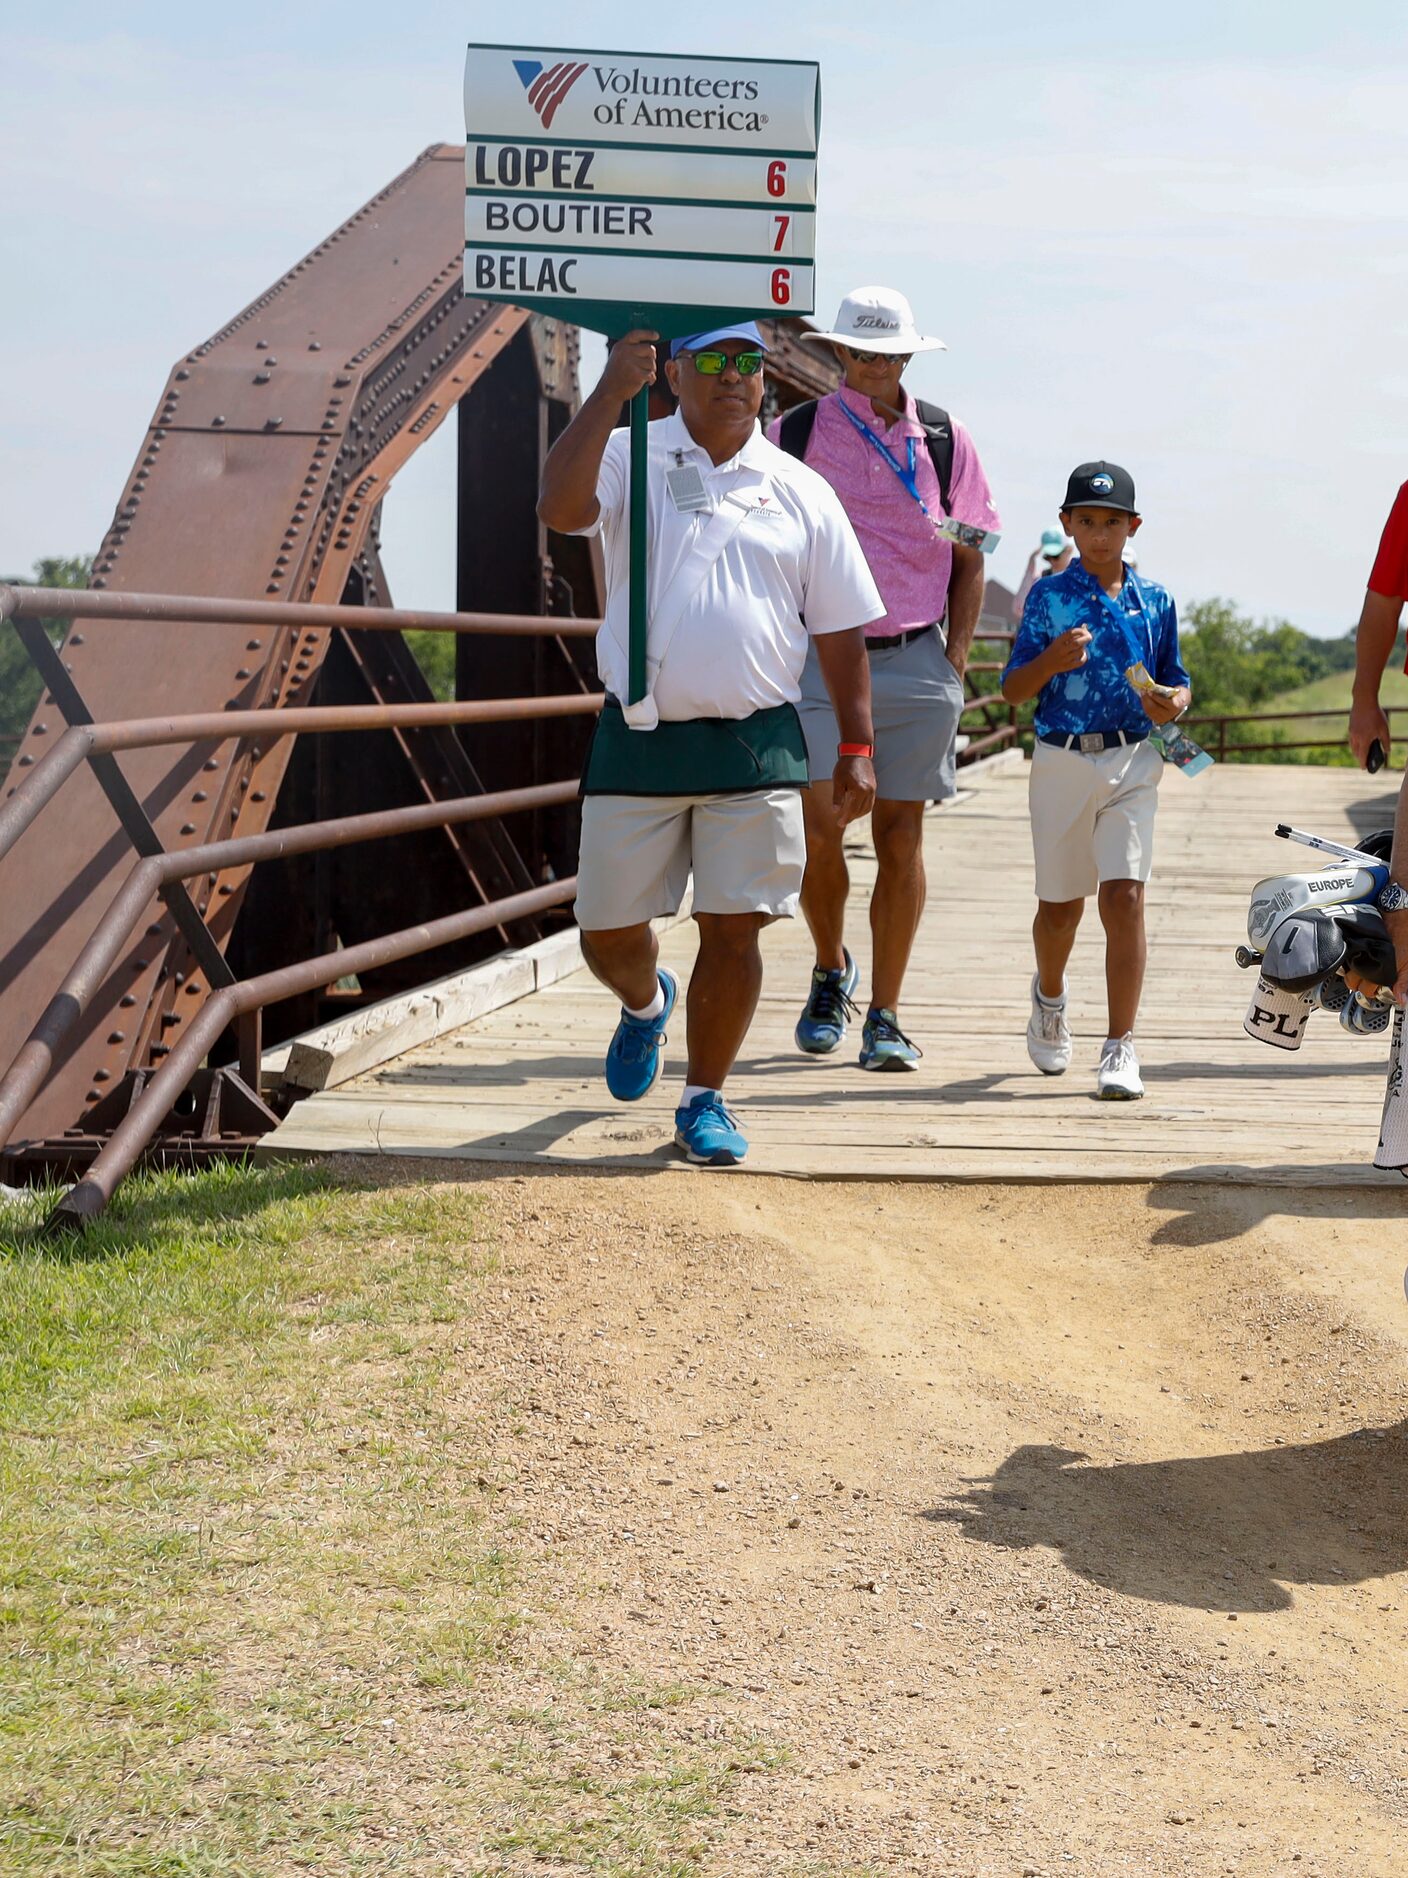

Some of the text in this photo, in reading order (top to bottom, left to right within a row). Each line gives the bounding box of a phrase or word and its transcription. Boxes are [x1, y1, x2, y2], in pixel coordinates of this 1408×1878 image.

[593, 67, 759, 100] Volunteers
[593, 98, 627, 126] of
[475, 145, 787, 197] LOPEZ 6
[486, 202, 790, 251] BOUTIER 7
[475, 254, 790, 304] BELAC 6
[1307, 878, 1355, 893] EUROPE
[1250, 1005, 1309, 1038] PL
